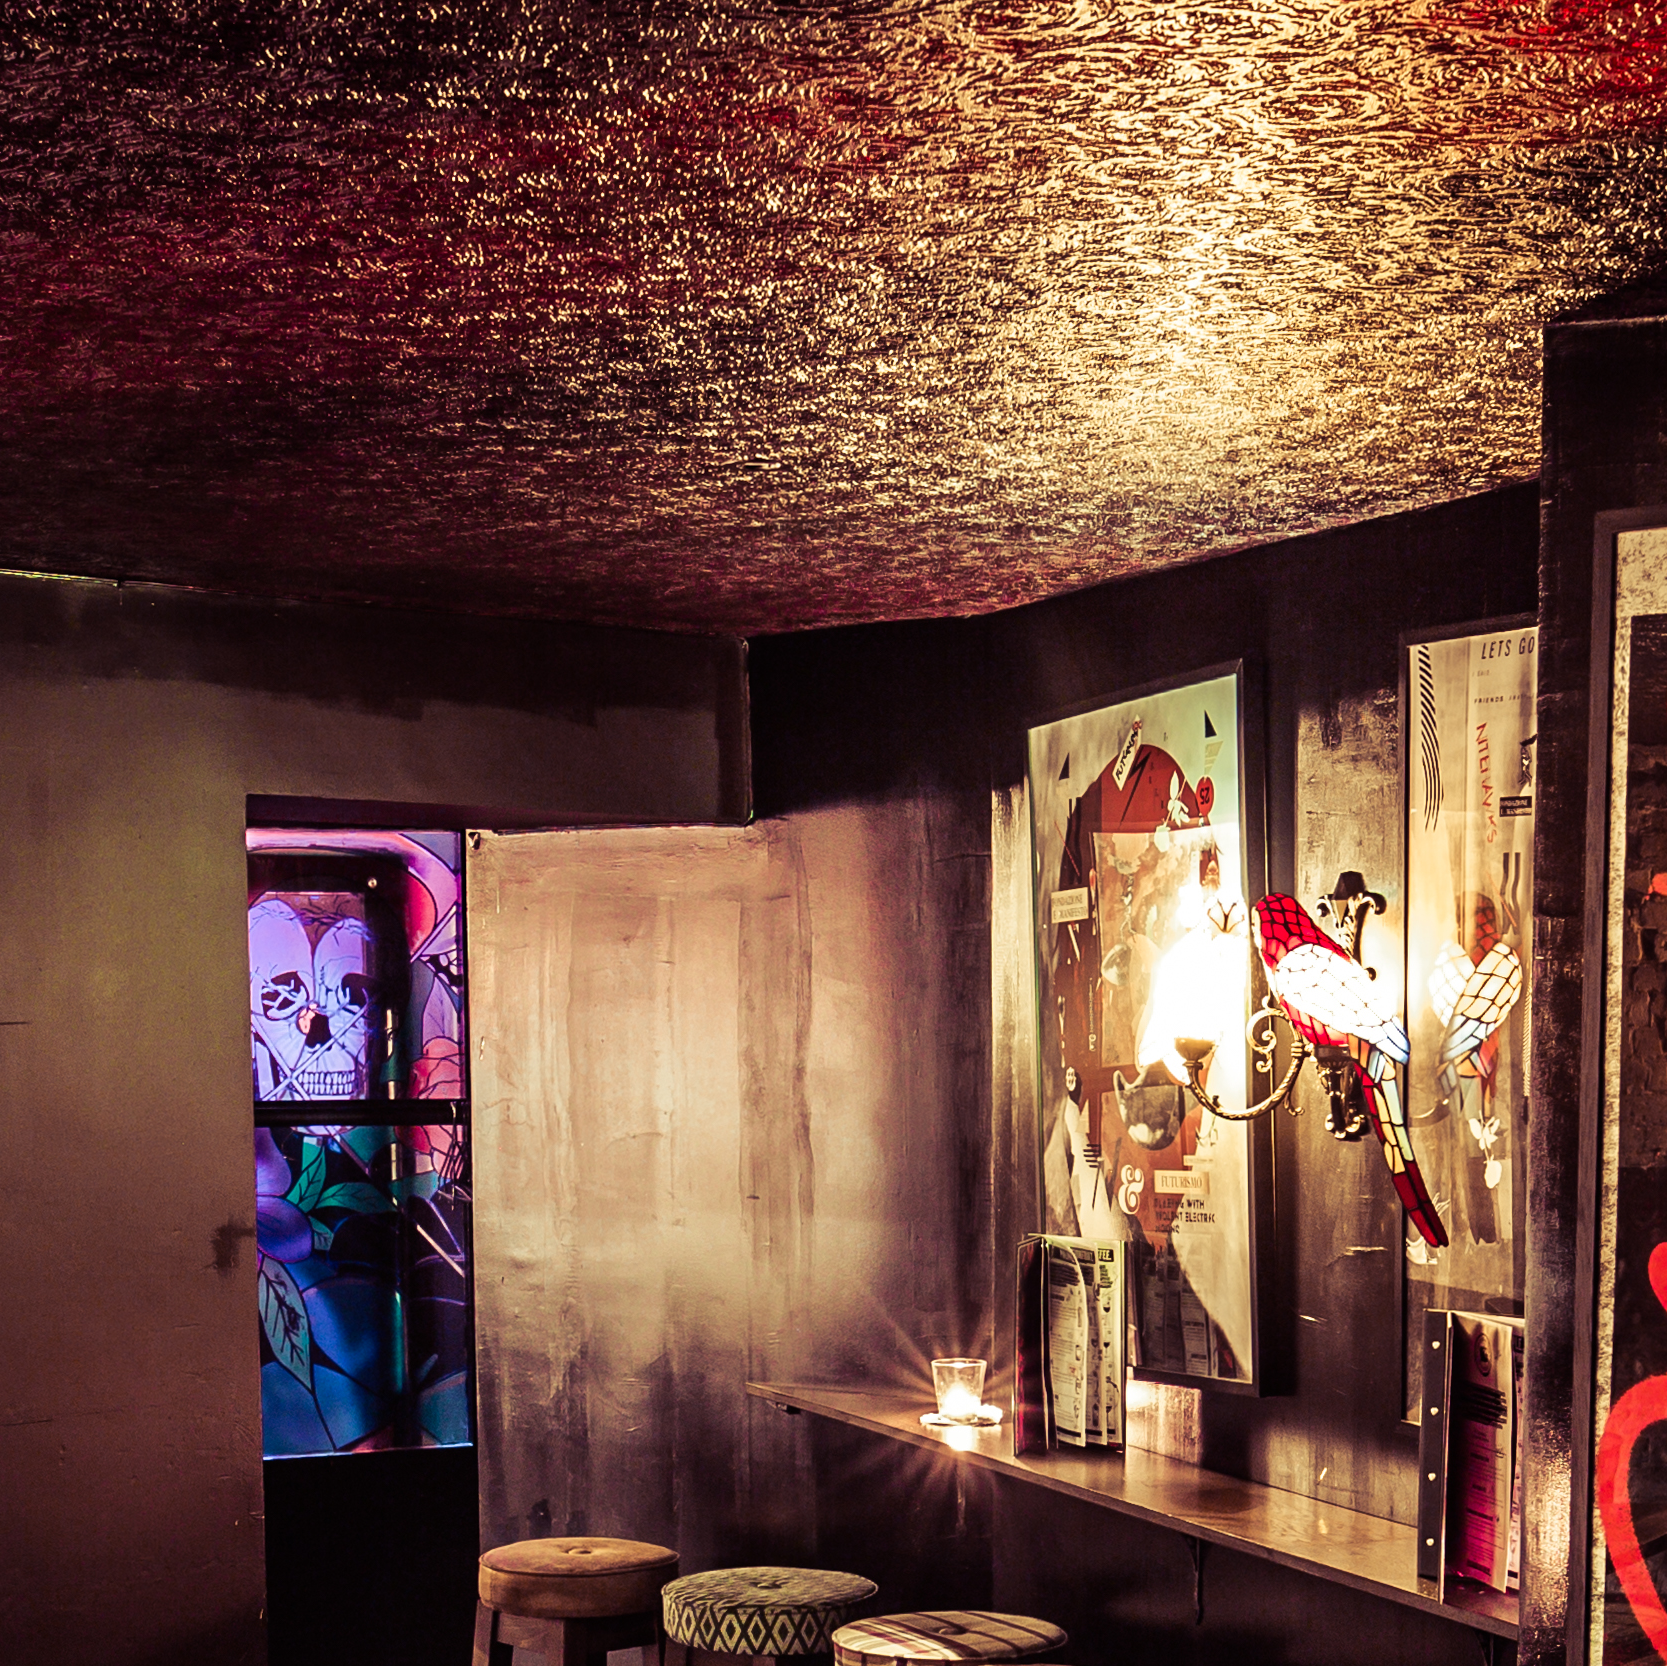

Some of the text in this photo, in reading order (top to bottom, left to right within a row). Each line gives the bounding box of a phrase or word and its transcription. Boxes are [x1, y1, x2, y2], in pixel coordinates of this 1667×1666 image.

[1481, 636, 1535, 660] LETS GO
[1161, 1175, 1203, 1189] FUTURISMO
